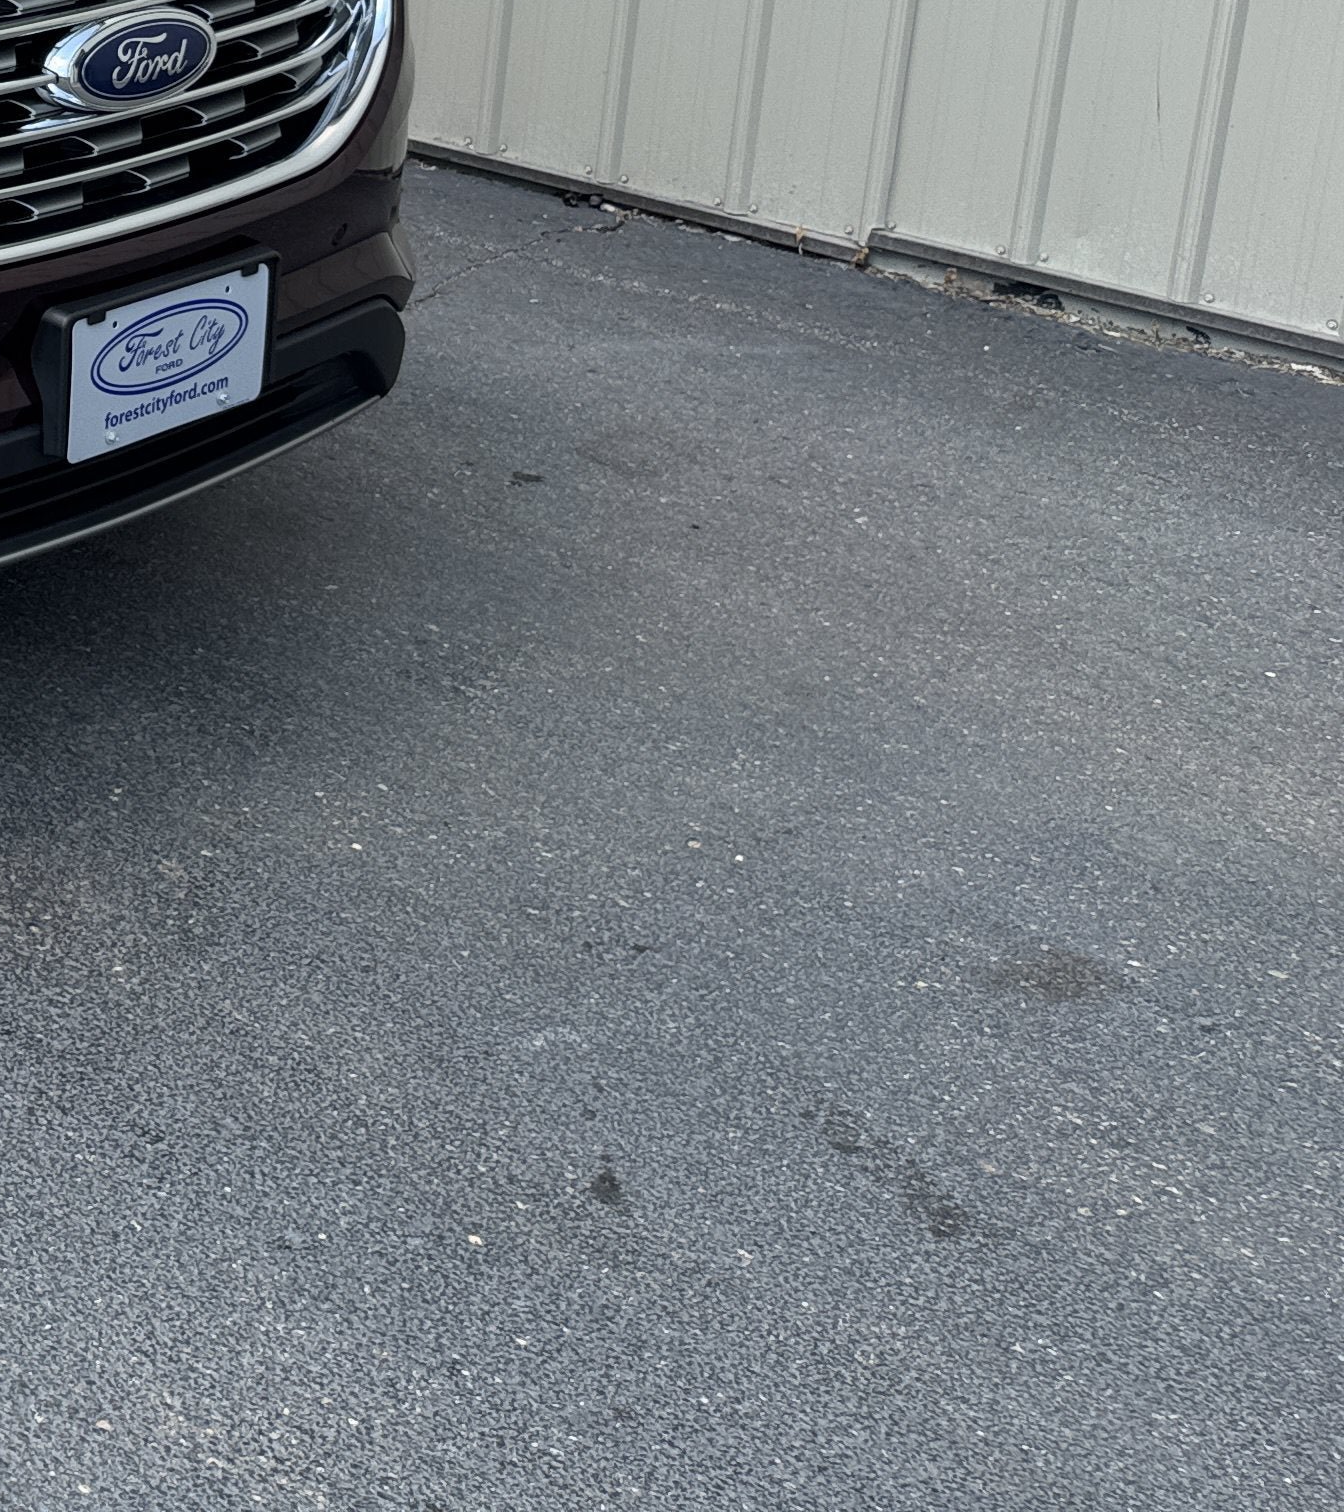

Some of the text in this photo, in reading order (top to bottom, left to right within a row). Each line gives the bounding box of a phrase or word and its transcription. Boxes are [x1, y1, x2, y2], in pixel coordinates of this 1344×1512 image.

[112, 32, 188, 89] Ford
[118, 314, 226, 372] Forest City
[155, 358, 184, 374] FORD
[104, 375, 229, 430] forestcityford.com
